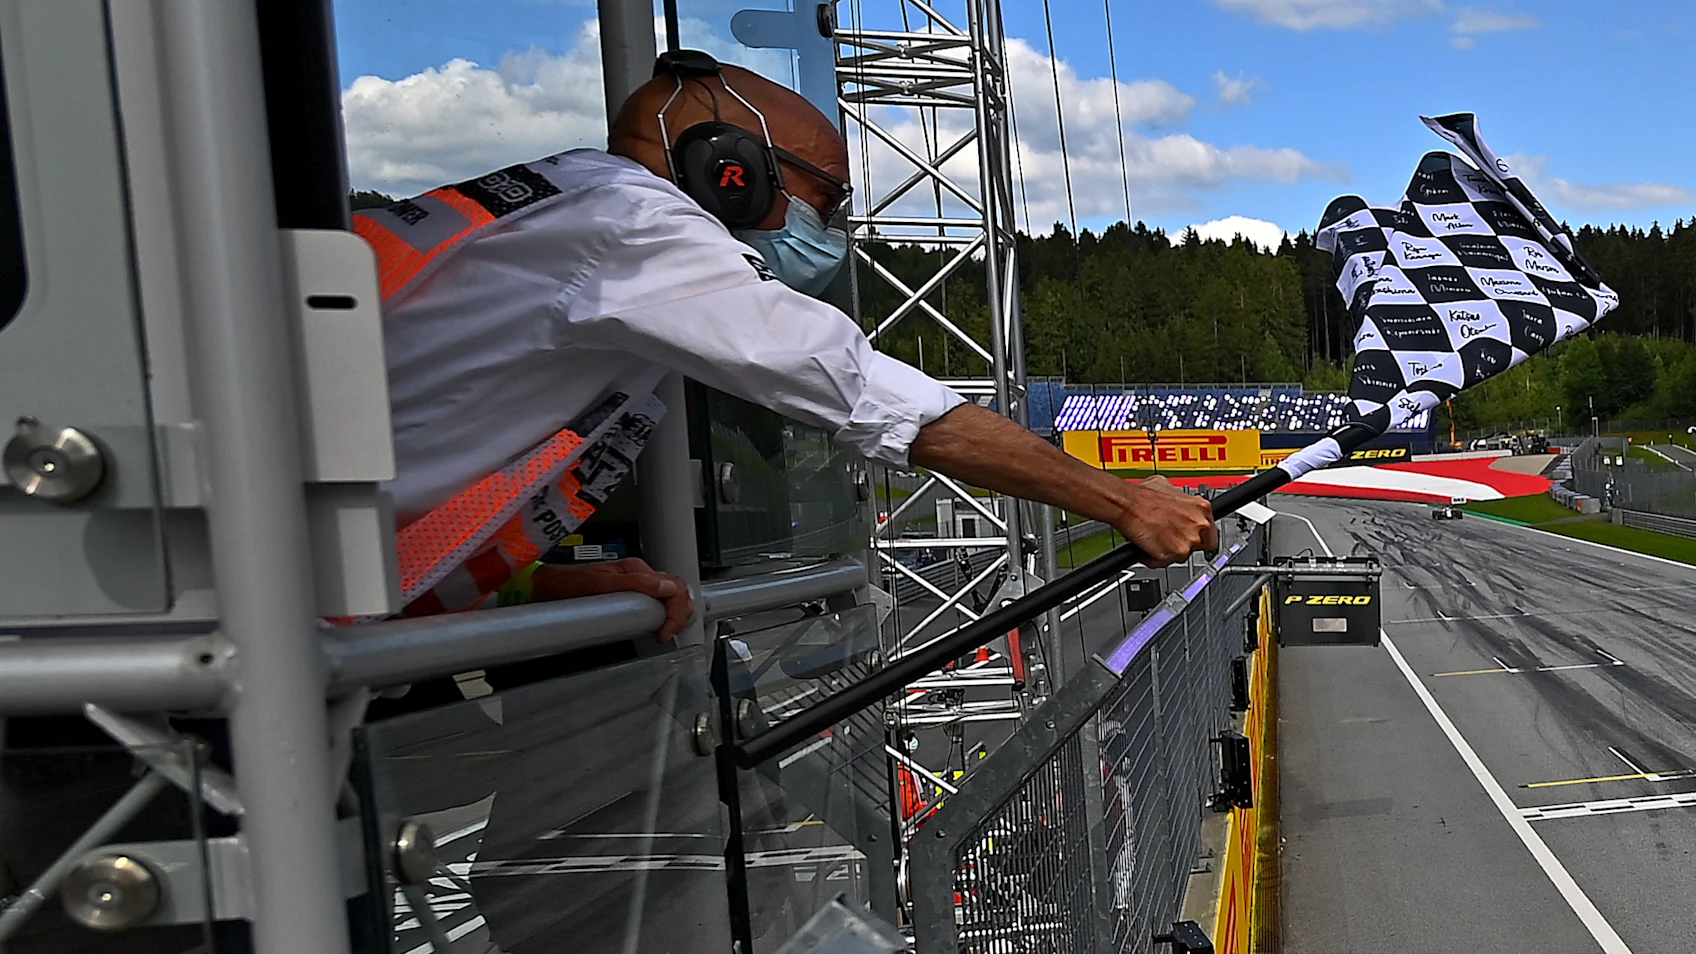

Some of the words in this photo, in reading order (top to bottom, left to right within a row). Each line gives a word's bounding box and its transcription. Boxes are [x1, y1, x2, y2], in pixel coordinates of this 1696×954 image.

[720, 166, 745, 187] R
[1101, 435, 1228, 462] PIRELLI
[1350, 448, 1406, 460] ZERO
[1284, 596, 1302, 605] P
[1305, 596, 1371, 605] ZERO
